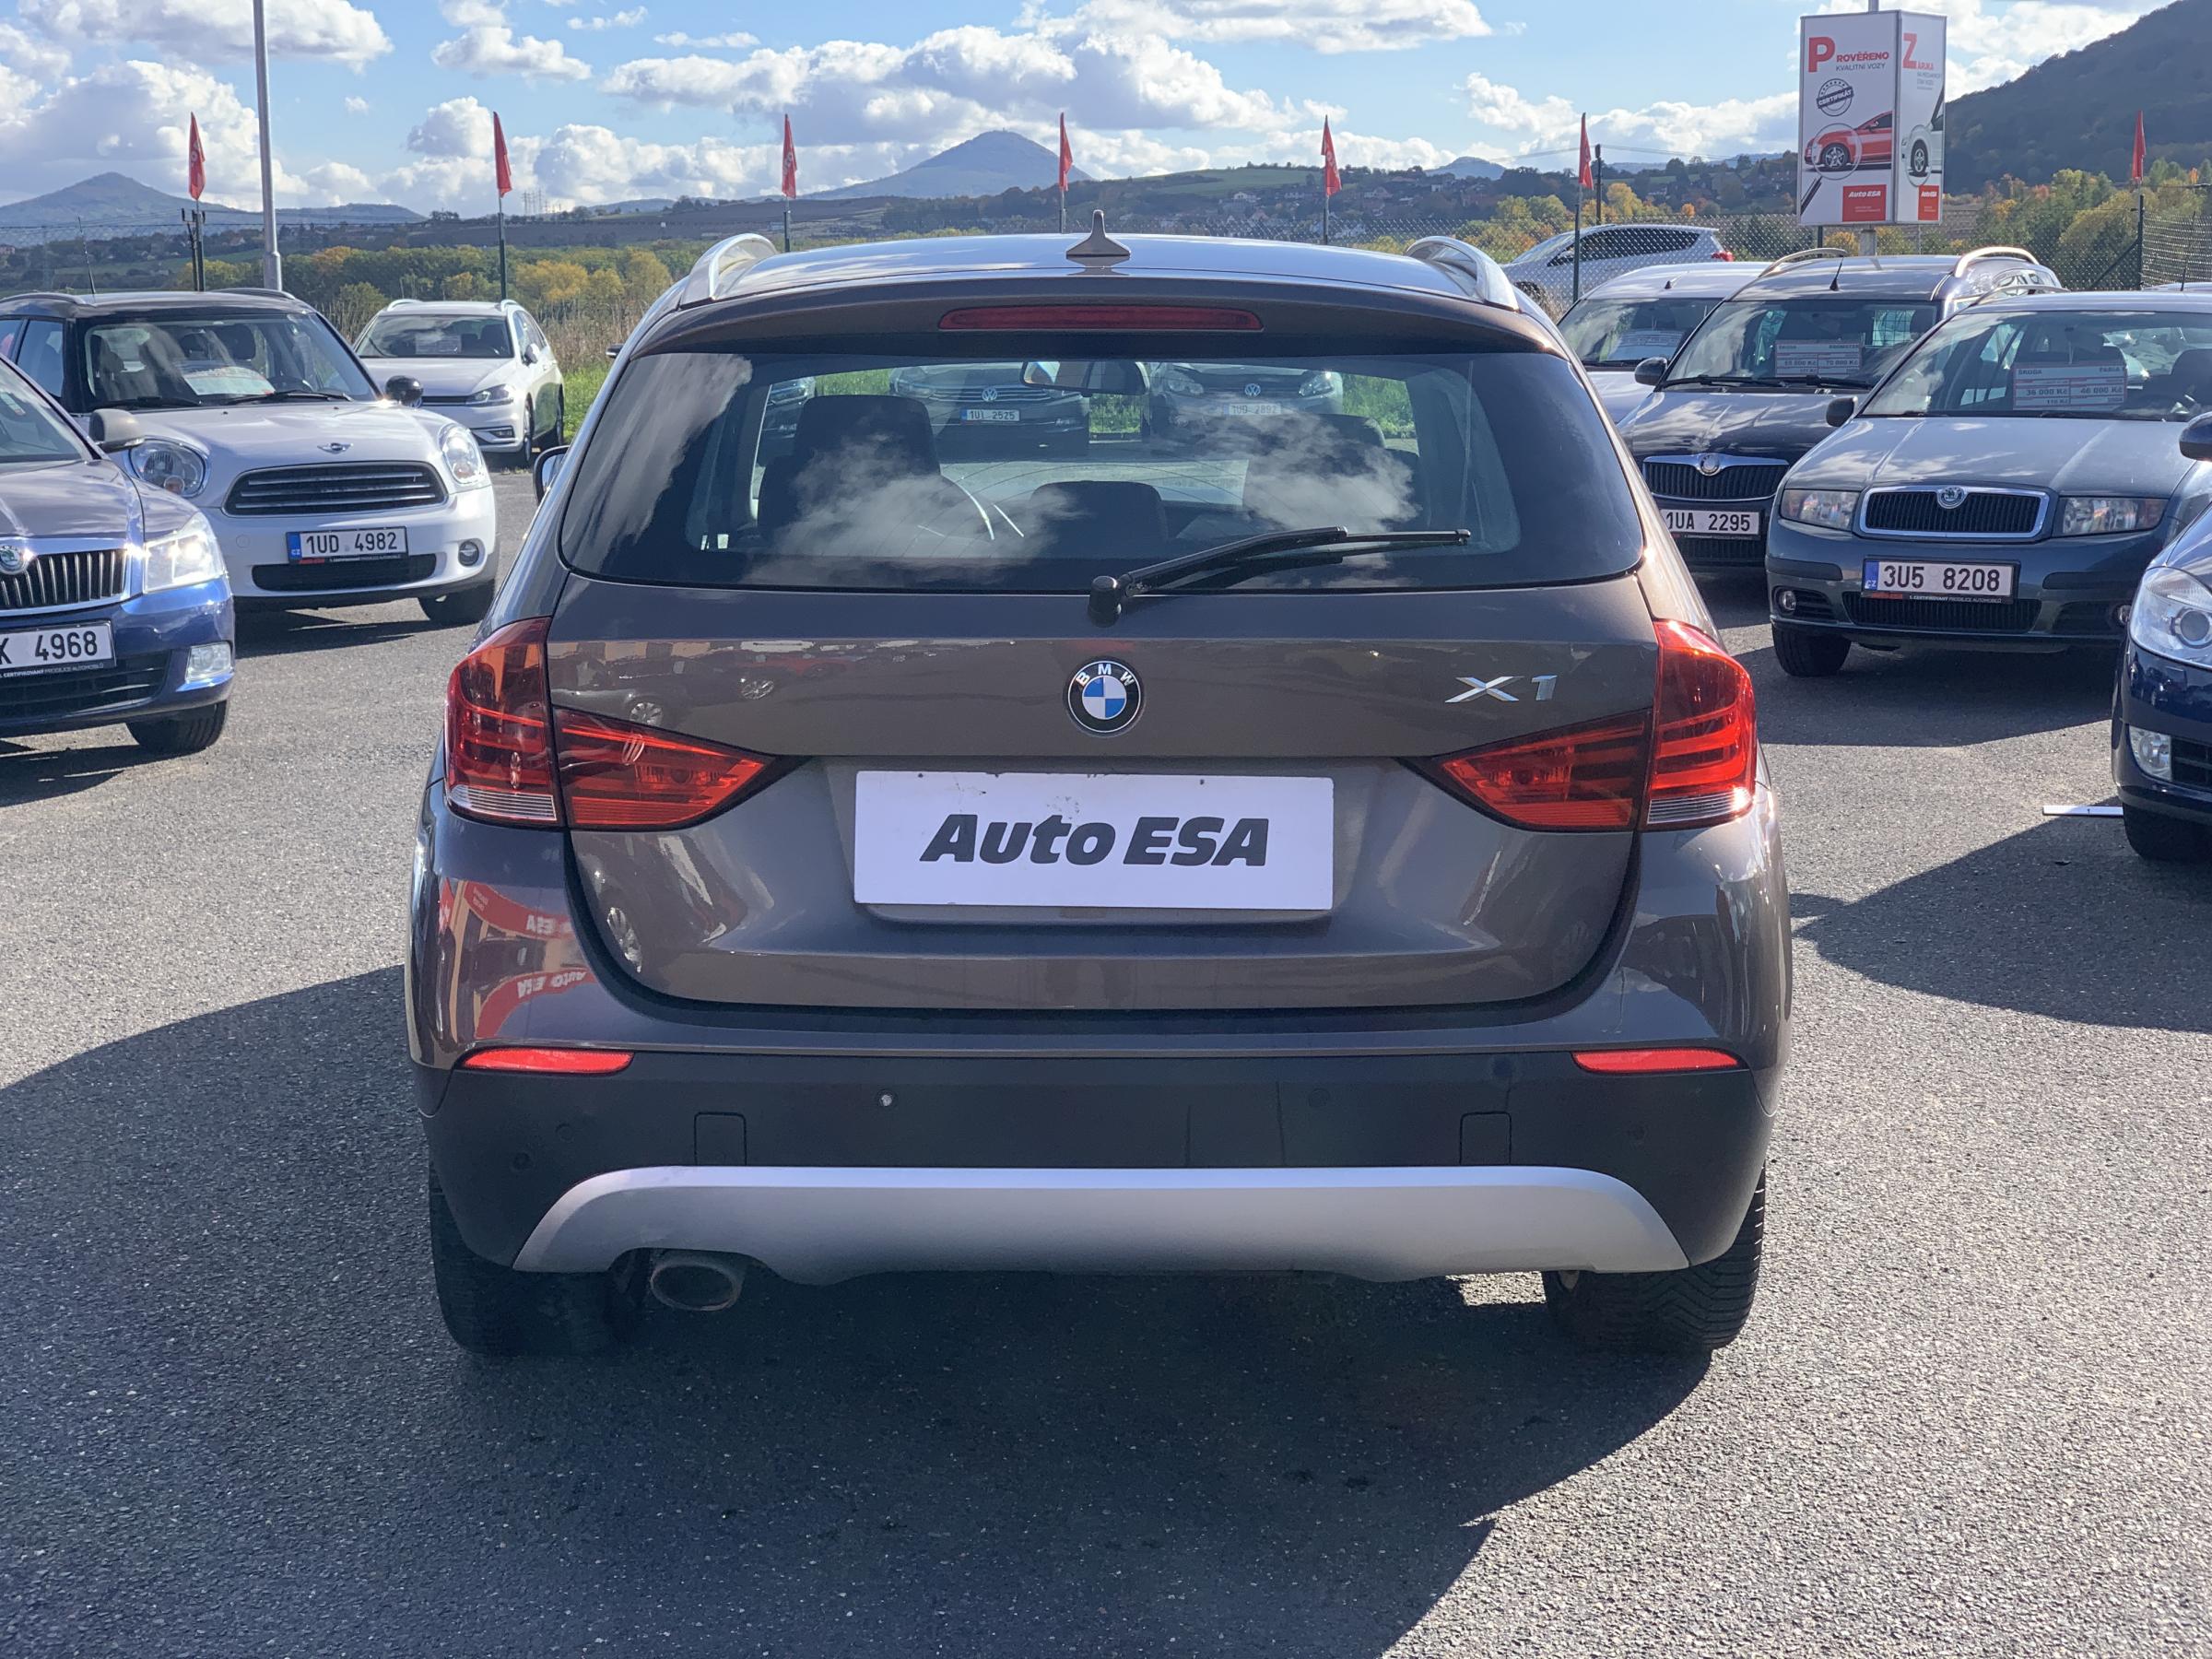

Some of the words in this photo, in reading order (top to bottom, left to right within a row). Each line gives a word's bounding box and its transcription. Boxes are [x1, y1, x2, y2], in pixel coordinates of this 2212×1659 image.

[992, 411, 1016, 420] 2525
[1665, 512, 1695, 530] 1UA
[1708, 513, 1750, 532] 2295
[306, 534, 339, 555] 1UD
[354, 532, 397, 552] 4982
[1883, 565, 1924, 589] 3U5
[1943, 567, 2000, 593] 8208
[34, 630, 98, 662] 4968
[1076, 663, 1135, 687] BMW
[1444, 675, 1558, 703] X1
[919, 814, 1116, 865] Auto
[1123, 817, 1269, 866] ESA
